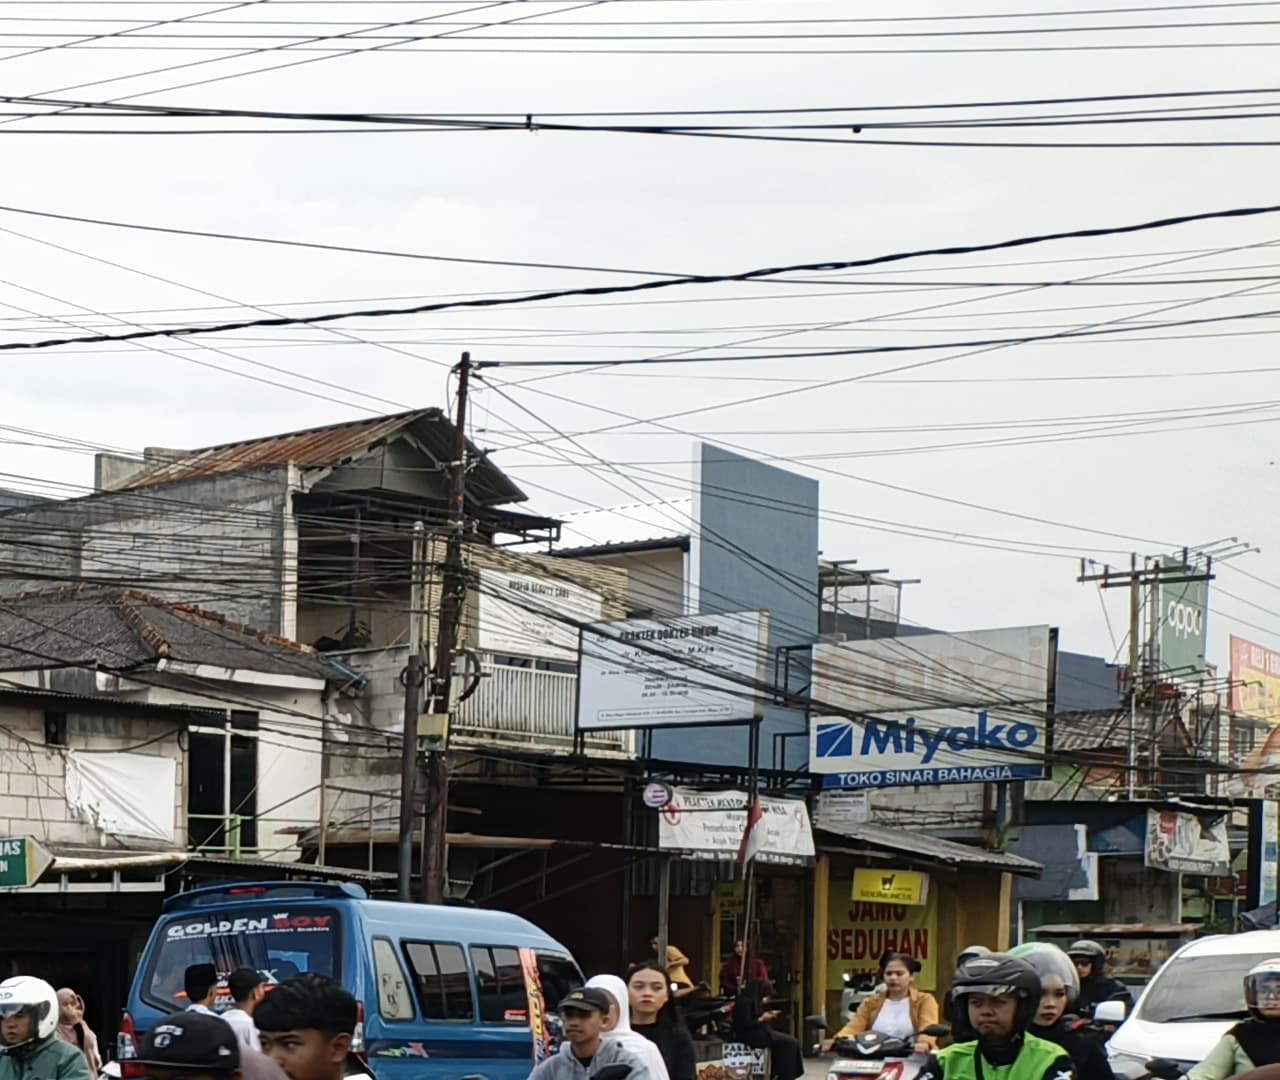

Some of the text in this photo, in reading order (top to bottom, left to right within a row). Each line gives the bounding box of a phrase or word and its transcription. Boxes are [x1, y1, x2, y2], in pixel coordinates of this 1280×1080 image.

[859, 711, 1038, 765] Miyako
[837, 765, 1013, 786] TOKO SINAR BAHAGIA
[167, 917, 268, 937] GOLDEN
[827, 927, 929, 961] SEDUHAN
